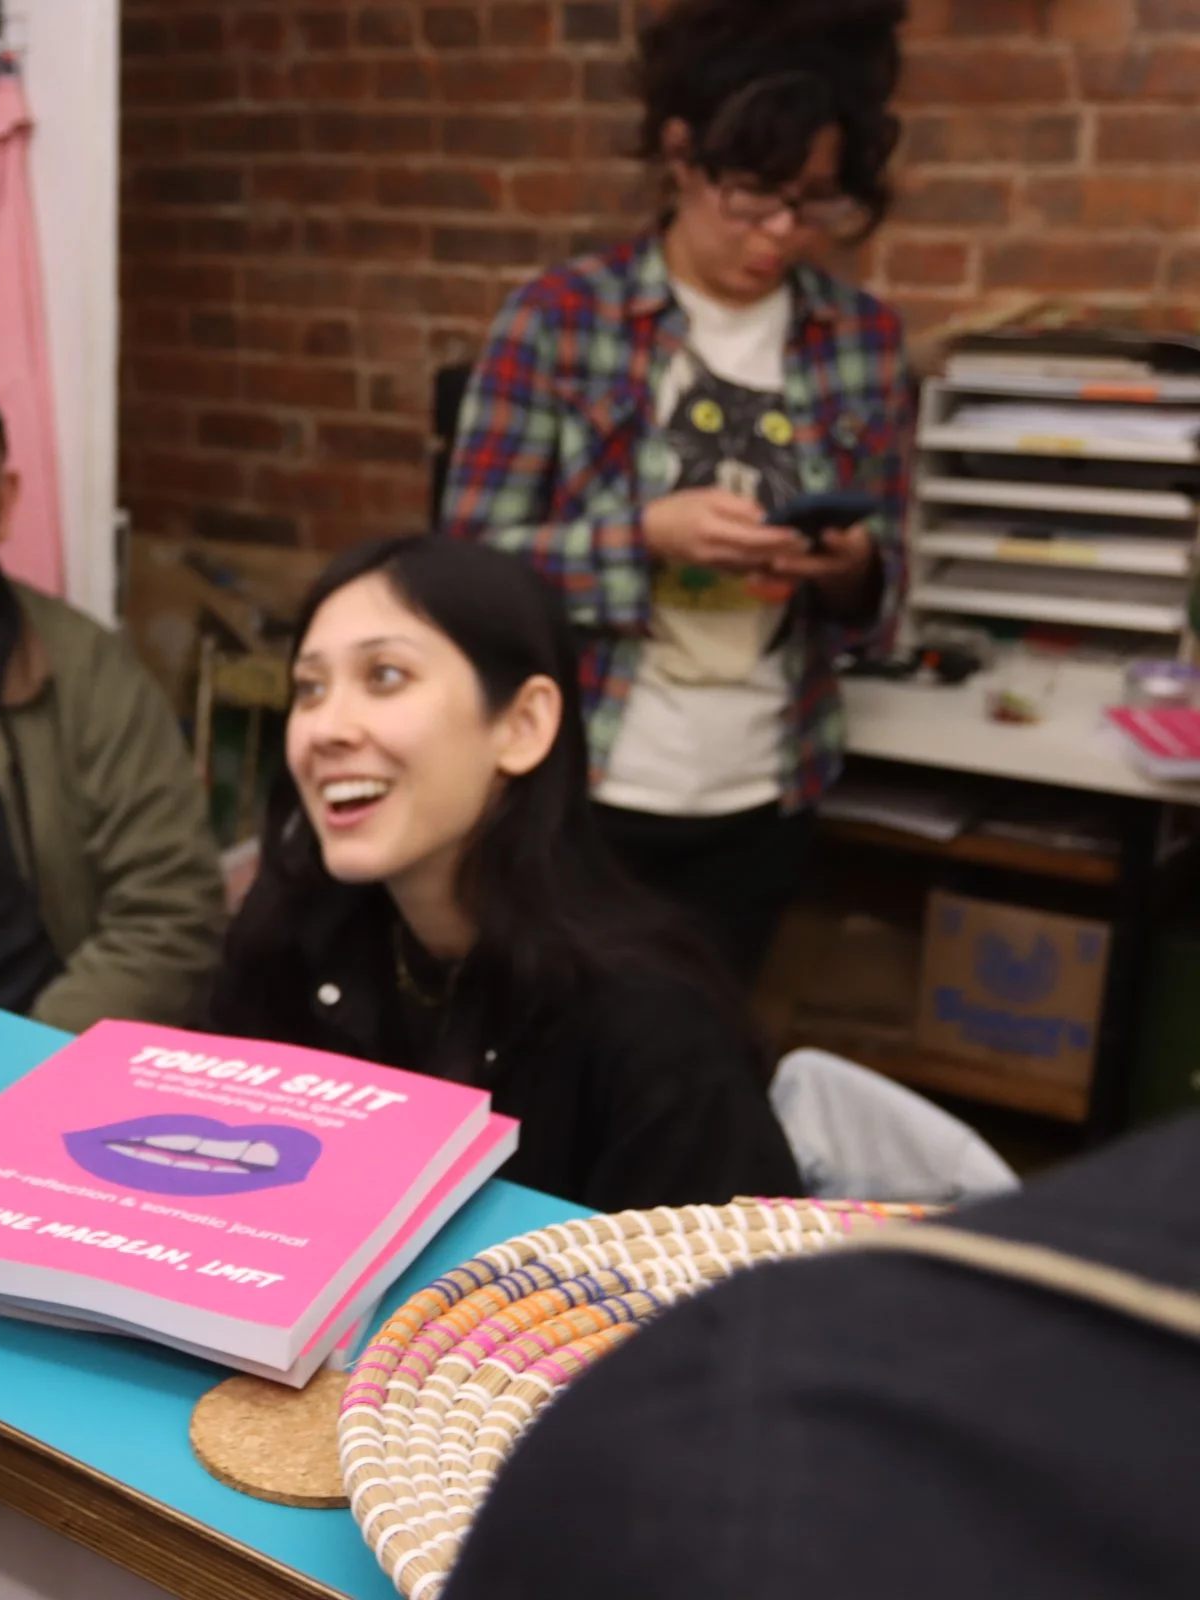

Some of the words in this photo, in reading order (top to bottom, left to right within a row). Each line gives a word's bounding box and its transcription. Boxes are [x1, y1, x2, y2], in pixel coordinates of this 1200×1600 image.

[128, 1044, 282, 1086] TOUGH
[156, 1084, 267, 1114] embodying
[268, 1104, 346, 1129] change
[309, 1101, 369, 1121] guide
[118, 1195, 137, 1208] &
[139, 1200, 228, 1229] somatic
[226, 1221, 311, 1248] journal
[195, 1259, 286, 1289] LMFT
